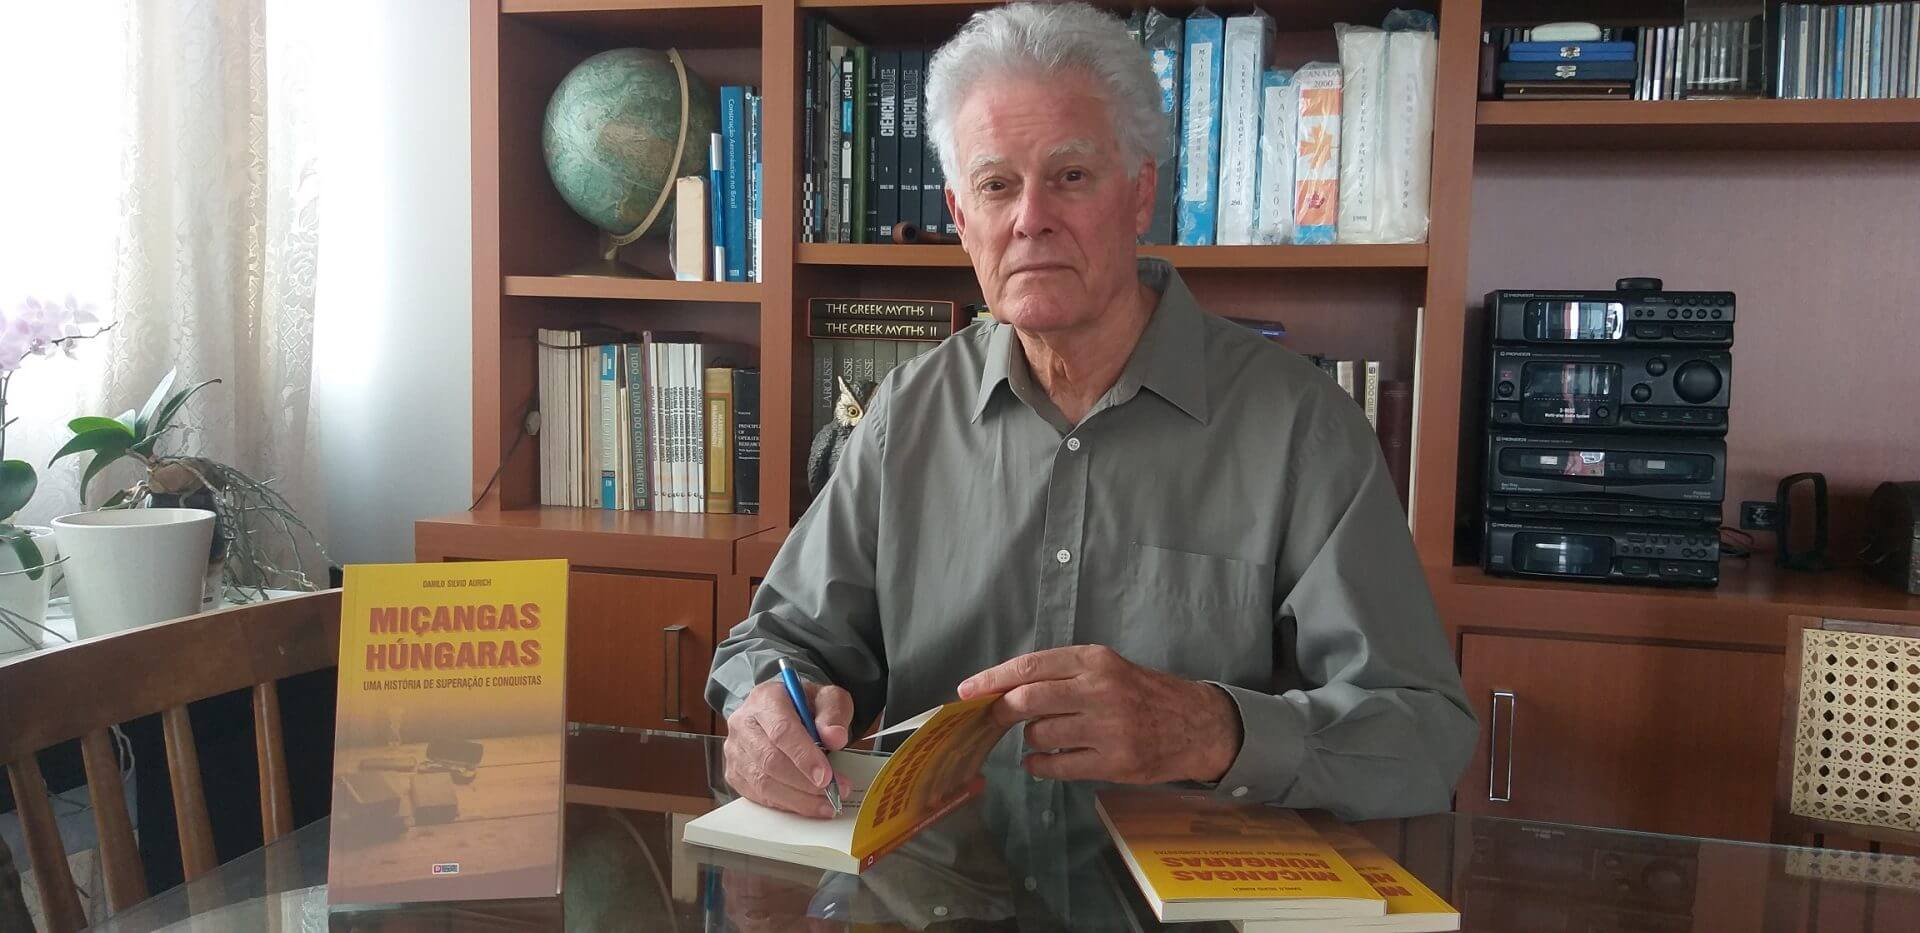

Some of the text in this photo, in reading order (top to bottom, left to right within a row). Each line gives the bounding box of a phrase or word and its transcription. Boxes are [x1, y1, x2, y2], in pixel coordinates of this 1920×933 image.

[842, 74, 852, 99] Help!
[1277, 89, 1286, 165] CANADA
[825, 303, 933, 316] THE GREEK MYTHS I
[825, 322, 936, 336] THE GREEK MYTHS II
[631, 352, 639, 375] TUDO
[823, 357, 833, 408] LAROUSSE
[633, 391, 641, 414] LIVRO
[634, 417, 641, 428] DO
[634, 431, 645, 493] CONHECIMENTO
[422, 578, 492, 588] DANILO SILVIO AURICH
[369, 602, 541, 636] MIÇANGAS
[365, 638, 542, 671] HÚNGARAS
[363, 675, 542, 691] UMA HISTÓRIA DE SUPERAÇÃO E CONQUISTAS
[1160, 856, 1330, 869] HÚNGARAS
[1173, 870, 1342, 883] MIÇANGAS
